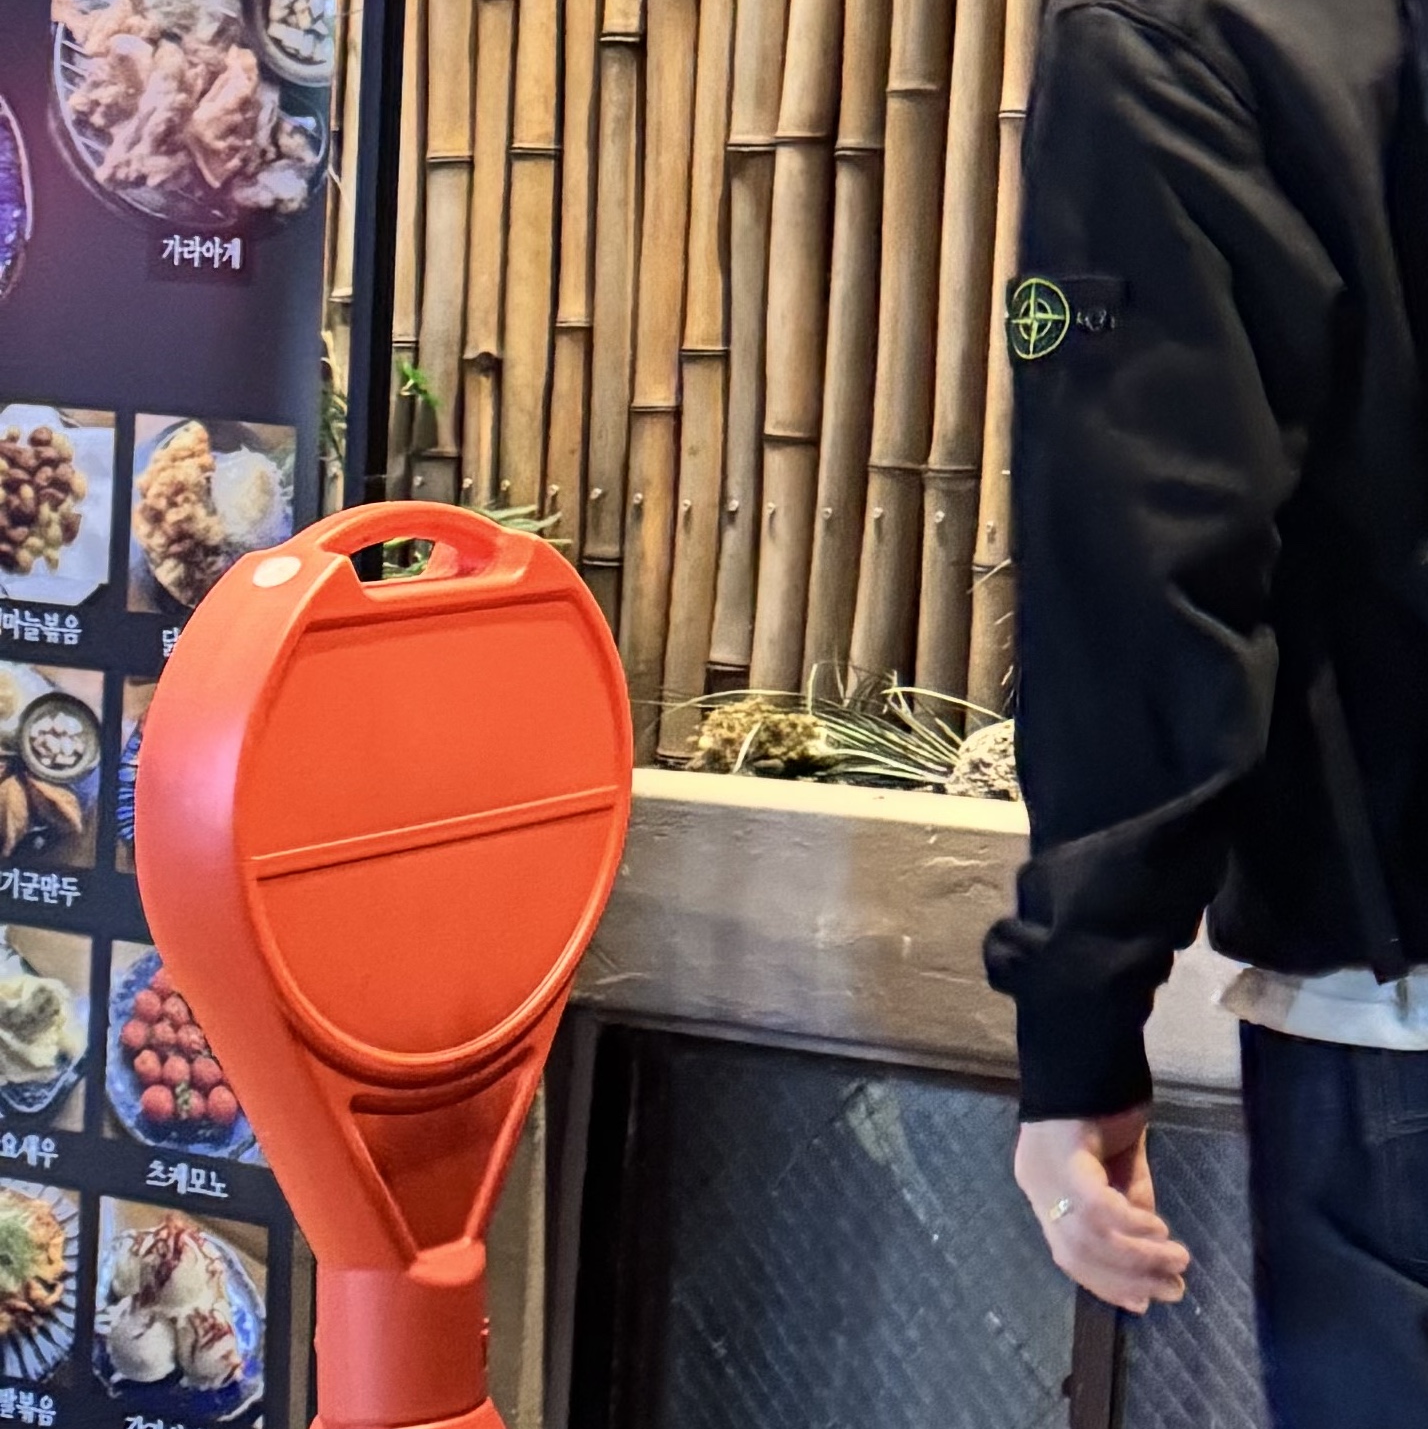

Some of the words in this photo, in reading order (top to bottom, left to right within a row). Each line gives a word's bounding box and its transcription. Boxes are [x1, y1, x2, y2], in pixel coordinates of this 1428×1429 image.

[162, 234, 241, 269] 가라아게
[0, 608, 83, 645] 마늘볶음
[146, 1160, 229, 1198] 츠케모노
